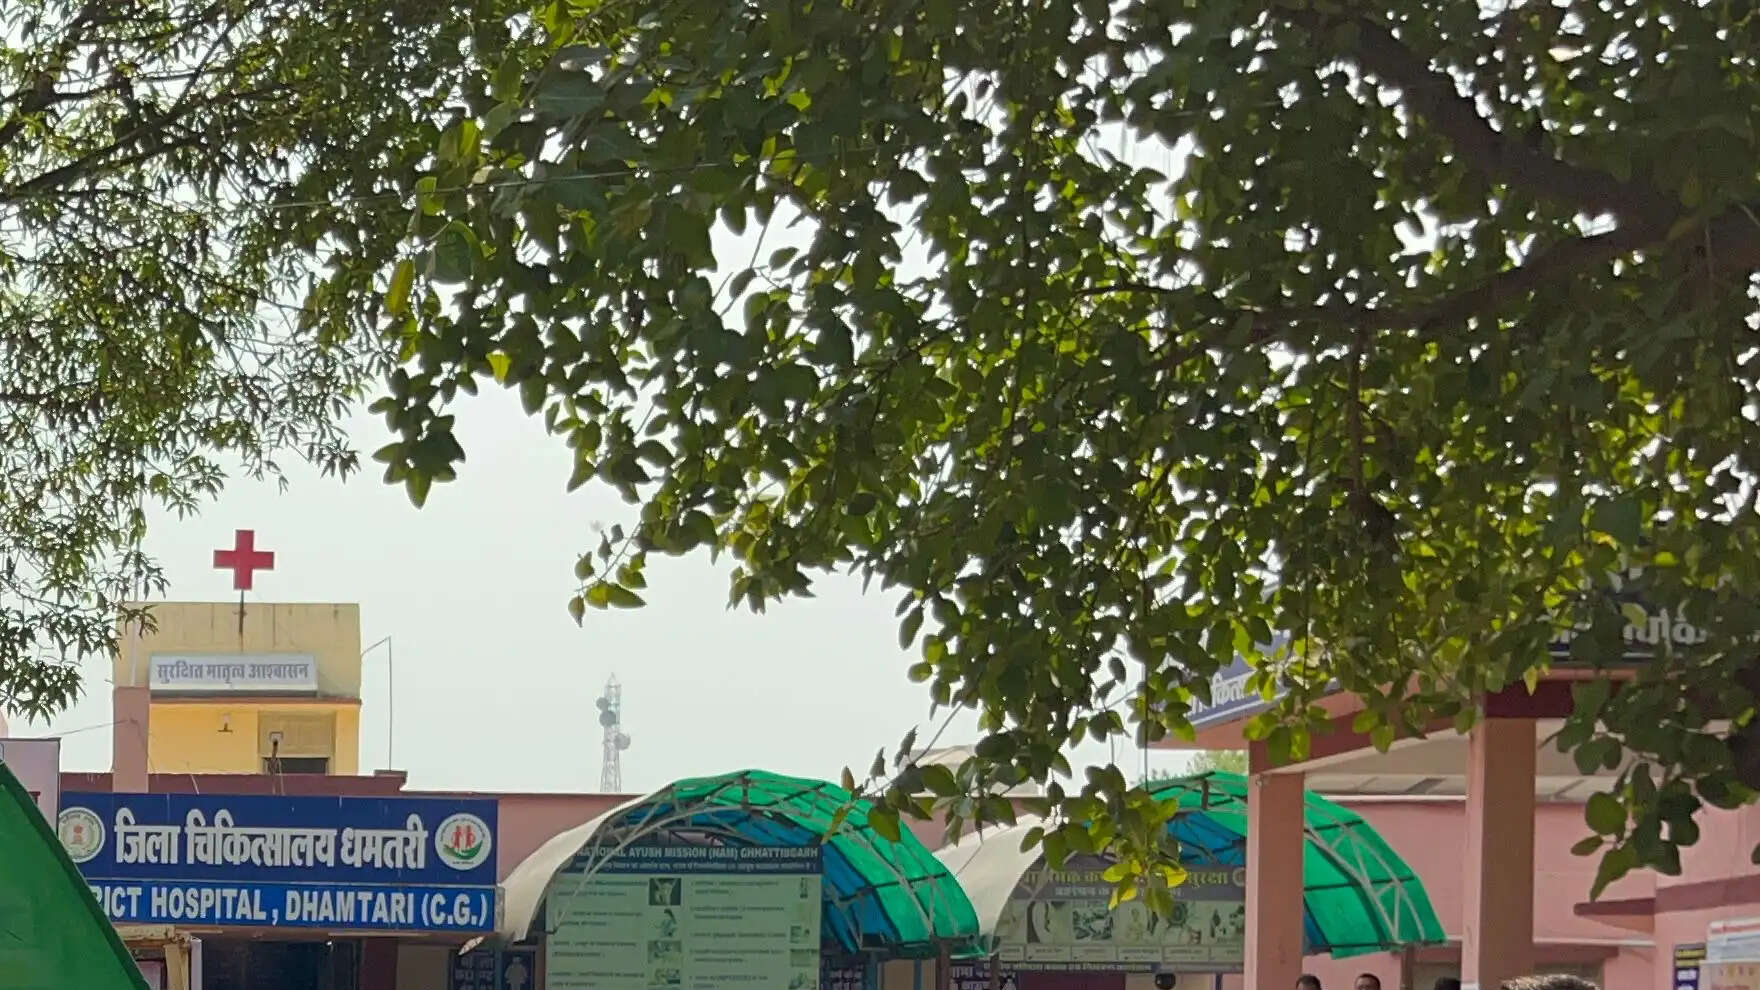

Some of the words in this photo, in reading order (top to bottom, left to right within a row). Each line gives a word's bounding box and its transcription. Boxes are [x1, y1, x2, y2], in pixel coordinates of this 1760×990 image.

[114, 807, 181, 865] जिला
[184, 808, 338, 868] चिकित्सालय
[340, 813, 429, 870] धमतरी
[285, 890, 414, 924] DHAMTARI
[421, 893, 488, 927] (C.G.)
